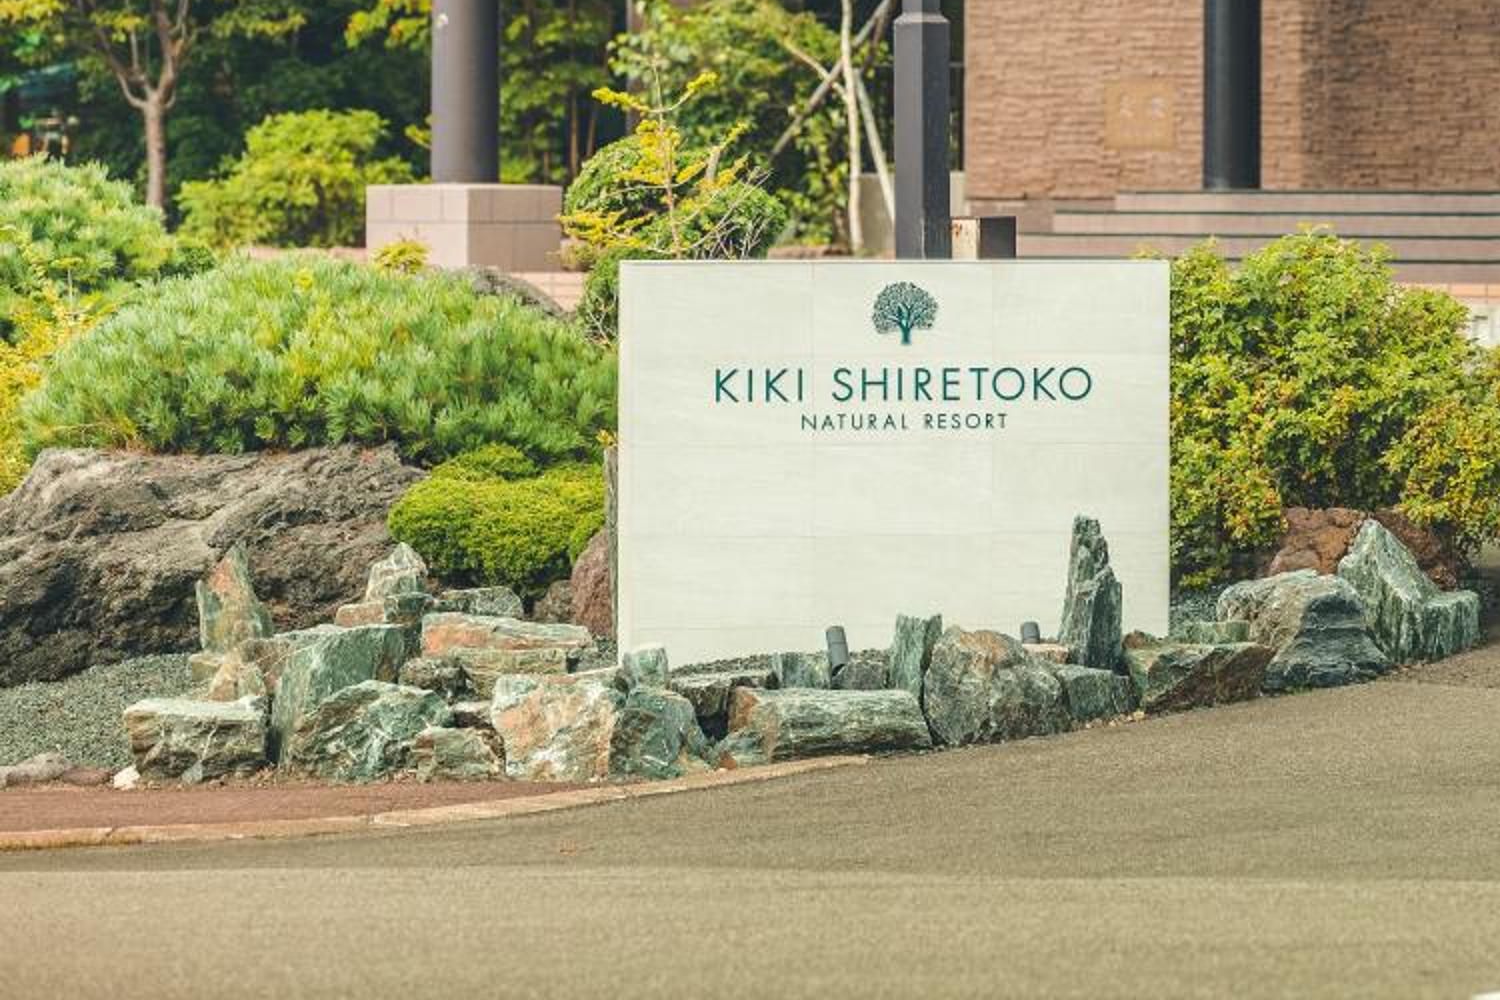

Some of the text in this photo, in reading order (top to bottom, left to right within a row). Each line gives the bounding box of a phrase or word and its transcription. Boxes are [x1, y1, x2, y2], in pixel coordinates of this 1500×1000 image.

[715, 366, 1092, 403] KIKI SHIRETOKO
[801, 412, 1007, 430] NATURAL RESORT
